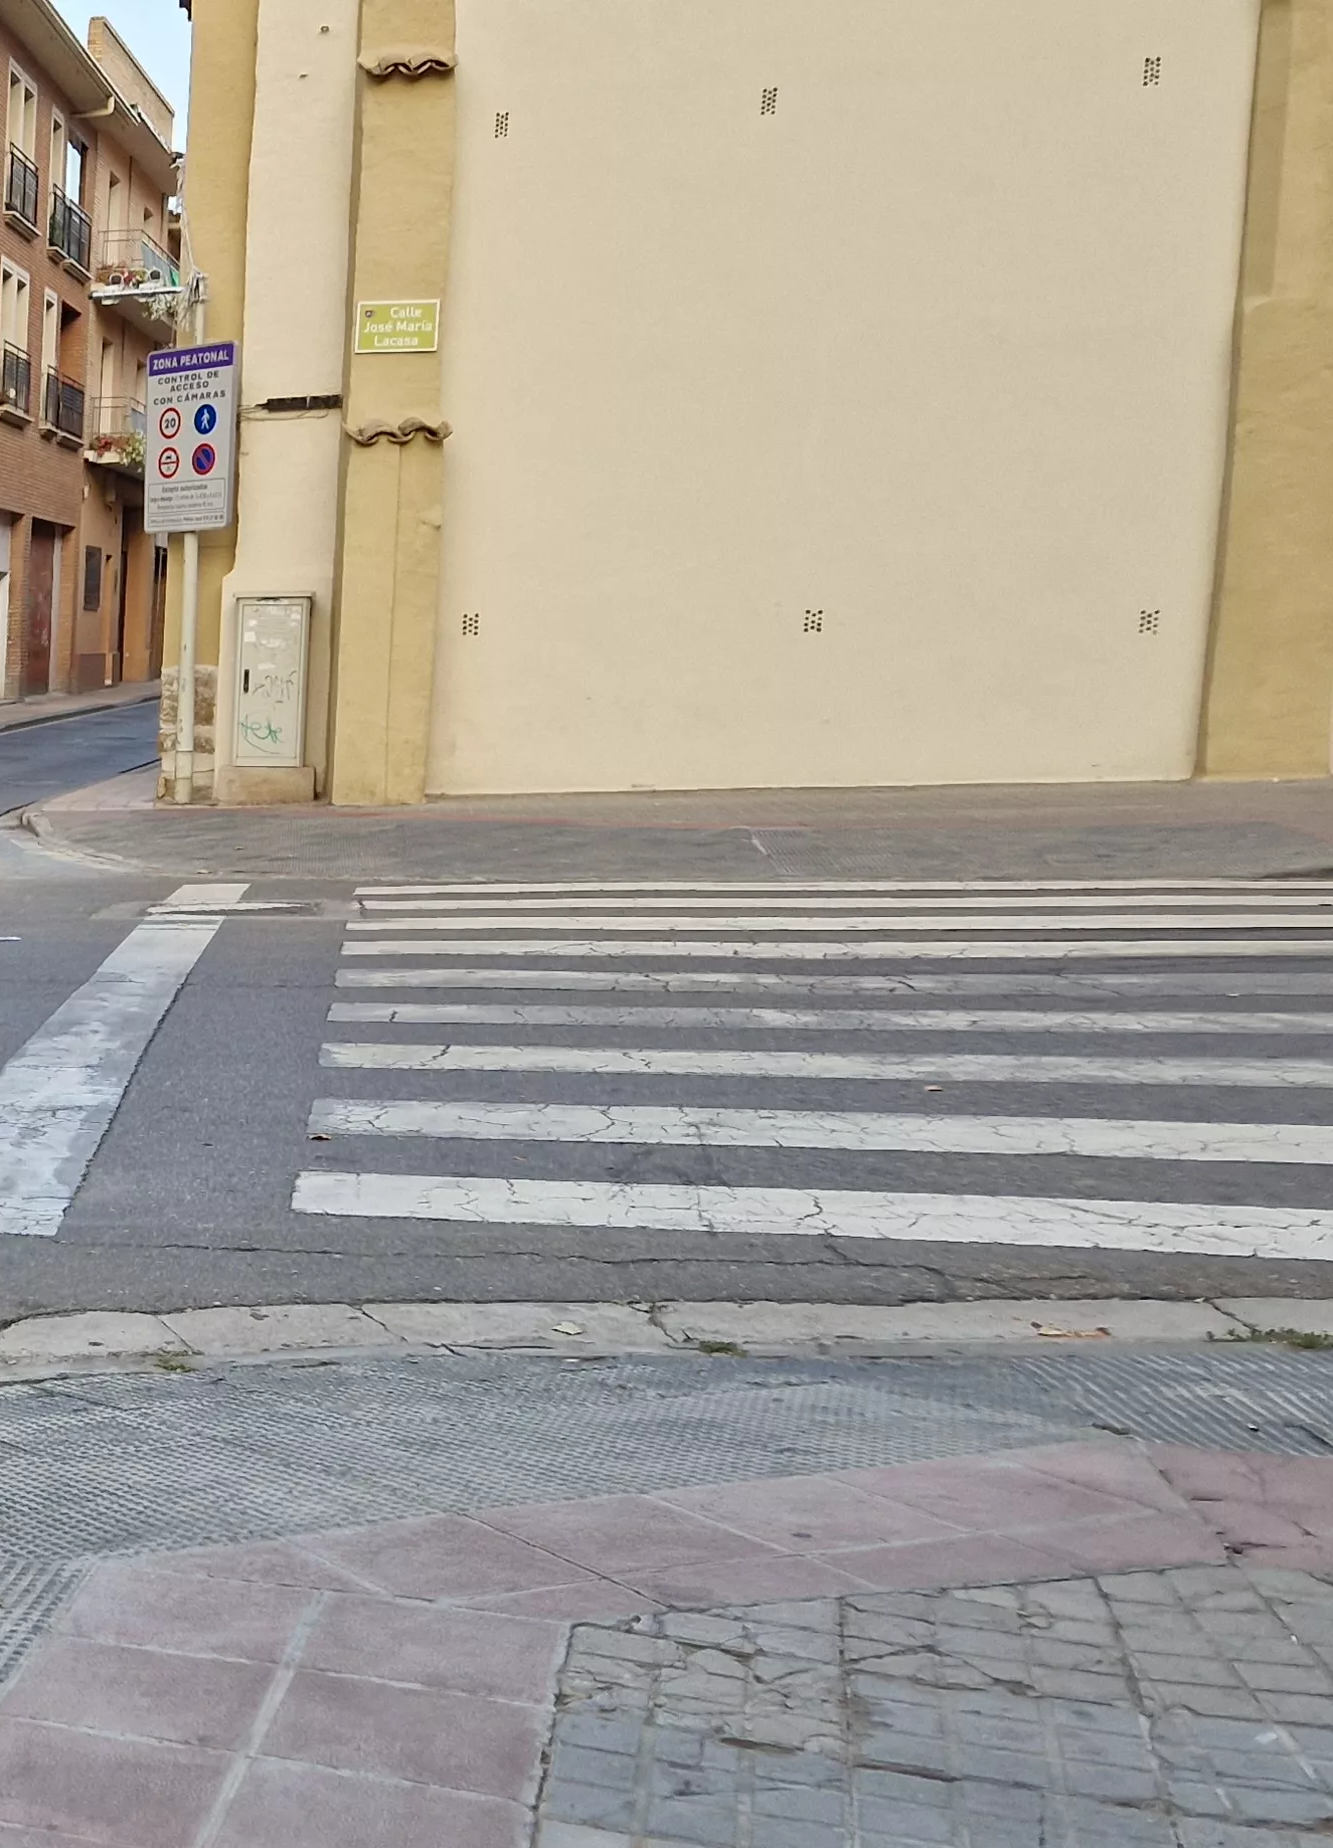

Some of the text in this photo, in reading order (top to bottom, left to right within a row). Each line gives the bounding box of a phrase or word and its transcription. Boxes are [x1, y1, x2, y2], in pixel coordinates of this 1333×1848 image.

[390, 306, 422, 318] Calle
[364, 320, 433, 333] José María
[374, 335, 418, 346] Lacasa
[153, 350, 229, 371] ZONA PEATONAL
[158, 370, 220, 385] CONTROL DE
[170, 381, 209, 393] ACCESO
[153, 389, 226, 406] CON CÁMARAS
[164, 417, 176, 430] 20
